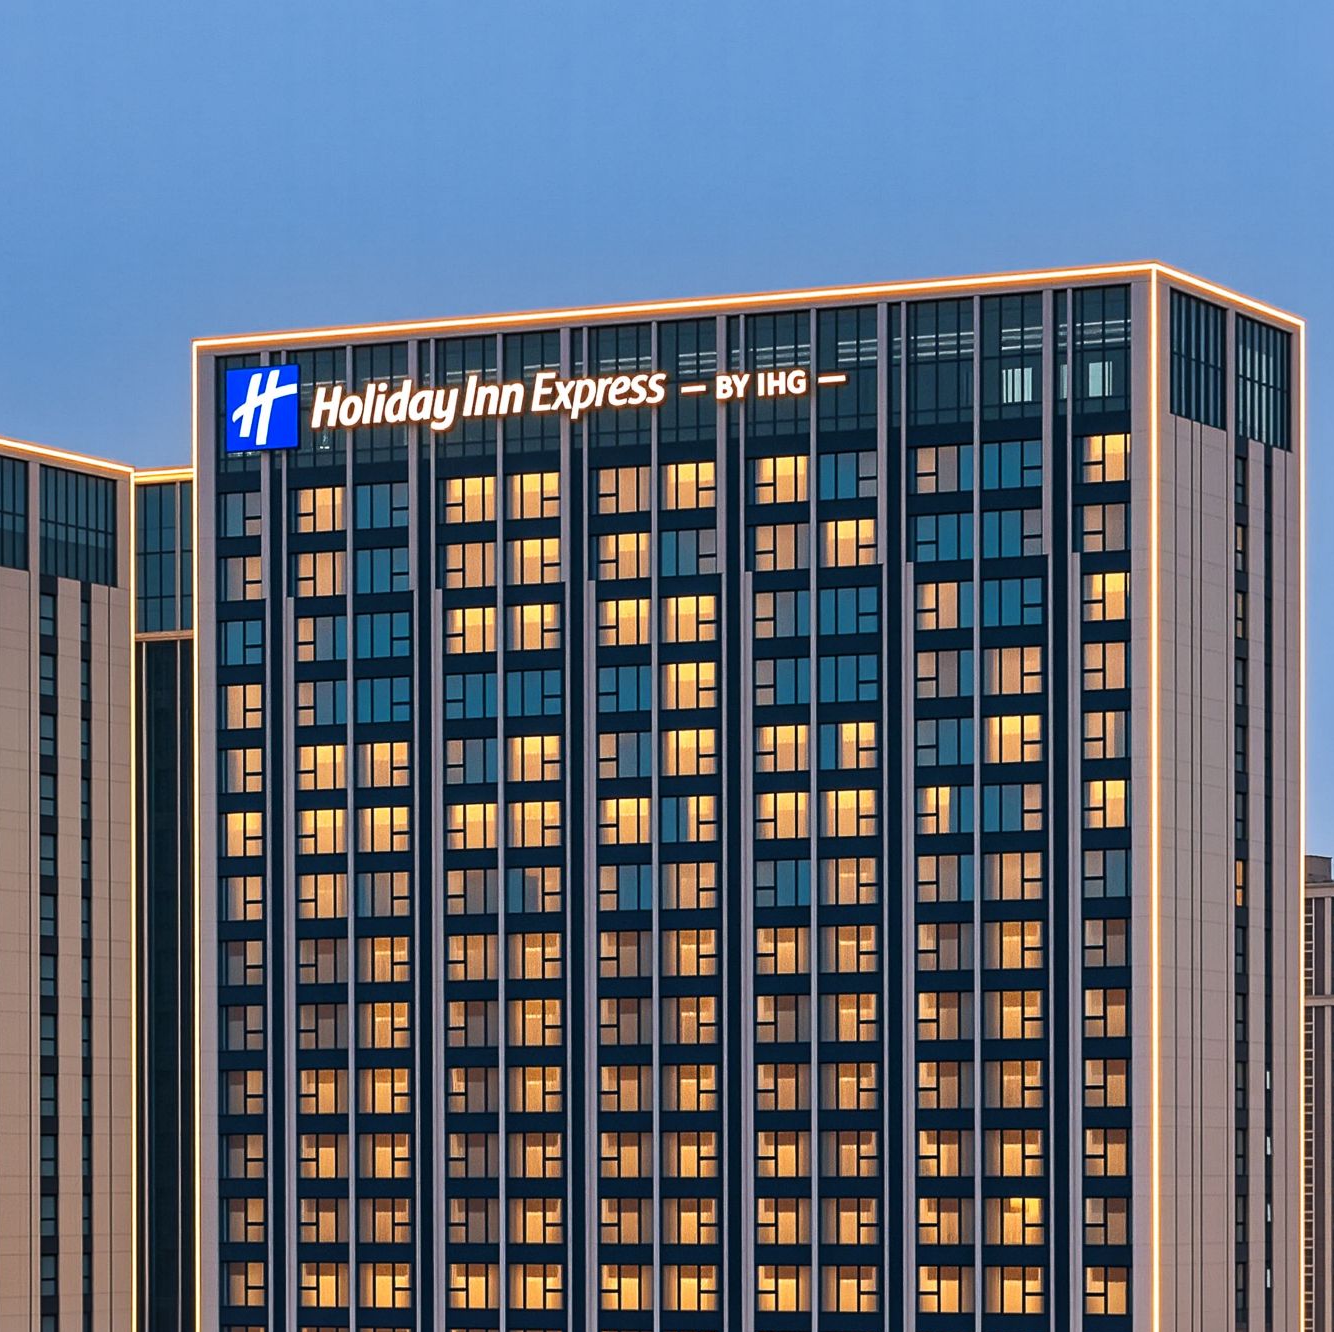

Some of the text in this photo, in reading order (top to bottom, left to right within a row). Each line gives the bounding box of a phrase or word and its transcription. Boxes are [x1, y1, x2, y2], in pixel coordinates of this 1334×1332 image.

[310, 369, 807, 431] Holiday Inn Express BY IHG
